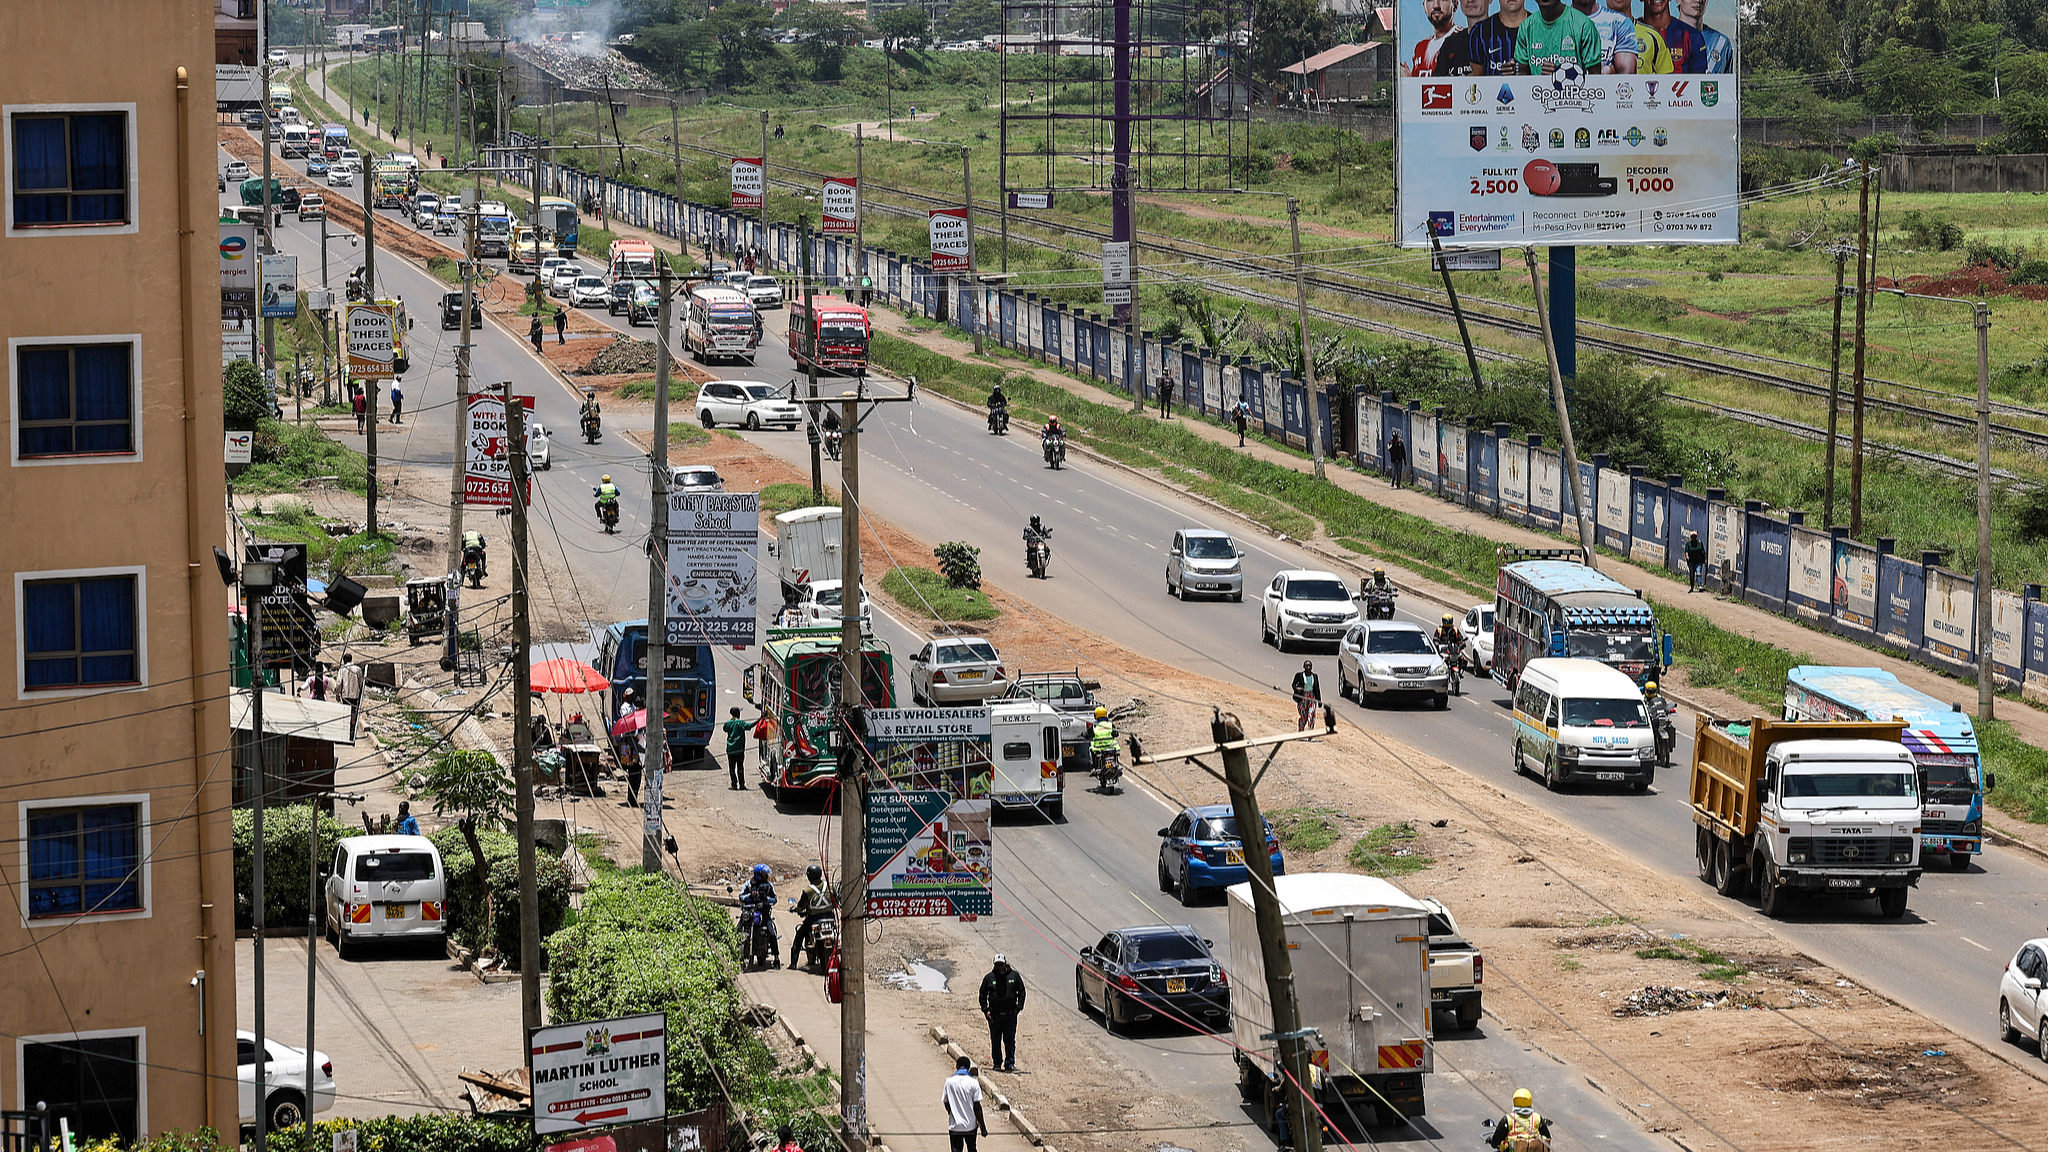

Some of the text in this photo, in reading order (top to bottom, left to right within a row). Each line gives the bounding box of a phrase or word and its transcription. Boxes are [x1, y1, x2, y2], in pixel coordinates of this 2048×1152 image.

[1532, 85, 1606, 104] SportPesa
[1598, 129, 1619, 139] AFL
[1470, 180, 1518, 196] 2,500
[1626, 178, 1674, 195] 1,000
[1460, 214, 1515, 222] Entertainment
[932, 241, 968, 249] SPACES
[354, 318, 386, 326] BOOK
[352, 330, 389, 339] THESE
[350, 342, 392, 351] SPACES
[350, 364, 393, 373] 0725 654 385
[472, 411, 496, 420] WITH
[471, 462, 487, 471] AD
[466, 481, 509, 494] 0725 654
[695, 512, 731, 529] School
[1760, 540, 1782, 556] NO POSTERS
[1890, 592, 1910, 610] Mwananchi
[678, 622, 754, 632] 0721 225 428
[1933, 619, 1941, 629] NEED
[1945, 621, 1953, 633] QUICK
[2034, 622, 2044, 635] TITLE
[2034, 635, 2044, 648] DEED
[2034, 649, 2044, 662] LOAN
[871, 710, 986, 720] BELIS WHOLESALERS
[896, 725, 934, 734] RETAIL
[937, 725, 972, 733] STORE
[946, 875, 972, 883] Cream
[535, 1052, 661, 1084] MARTIN LUTHER
[579, 1078, 619, 1092] SCHOOL
